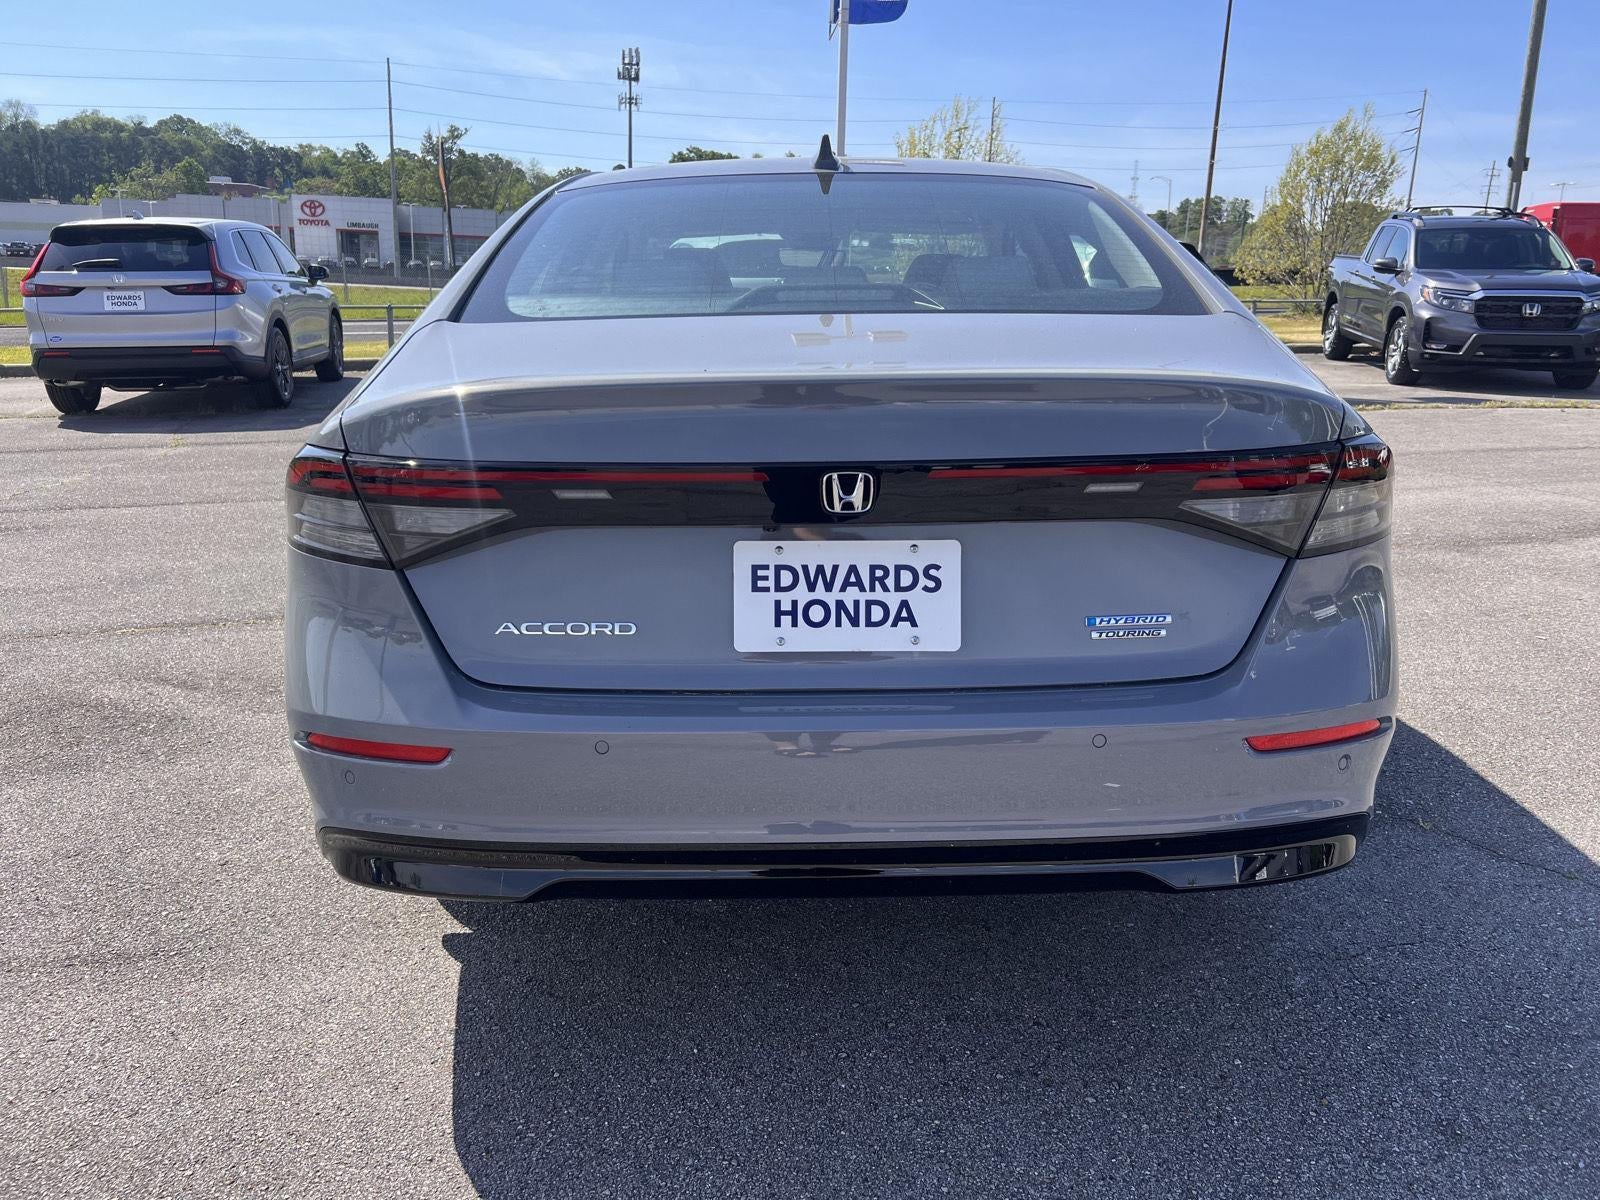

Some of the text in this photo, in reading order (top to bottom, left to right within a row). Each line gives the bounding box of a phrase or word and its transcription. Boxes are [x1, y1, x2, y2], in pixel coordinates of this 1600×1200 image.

[298, 219, 330, 227] TOYOTA
[346, 221, 379, 229] LIMBAUGH
[750, 563, 942, 593] EDWARDS
[774, 598, 919, 628] HONDA
[1098, 615, 1167, 625] HYBRID
[494, 621, 637, 636] ACCORD
[1096, 629, 1162, 638] TOURING
